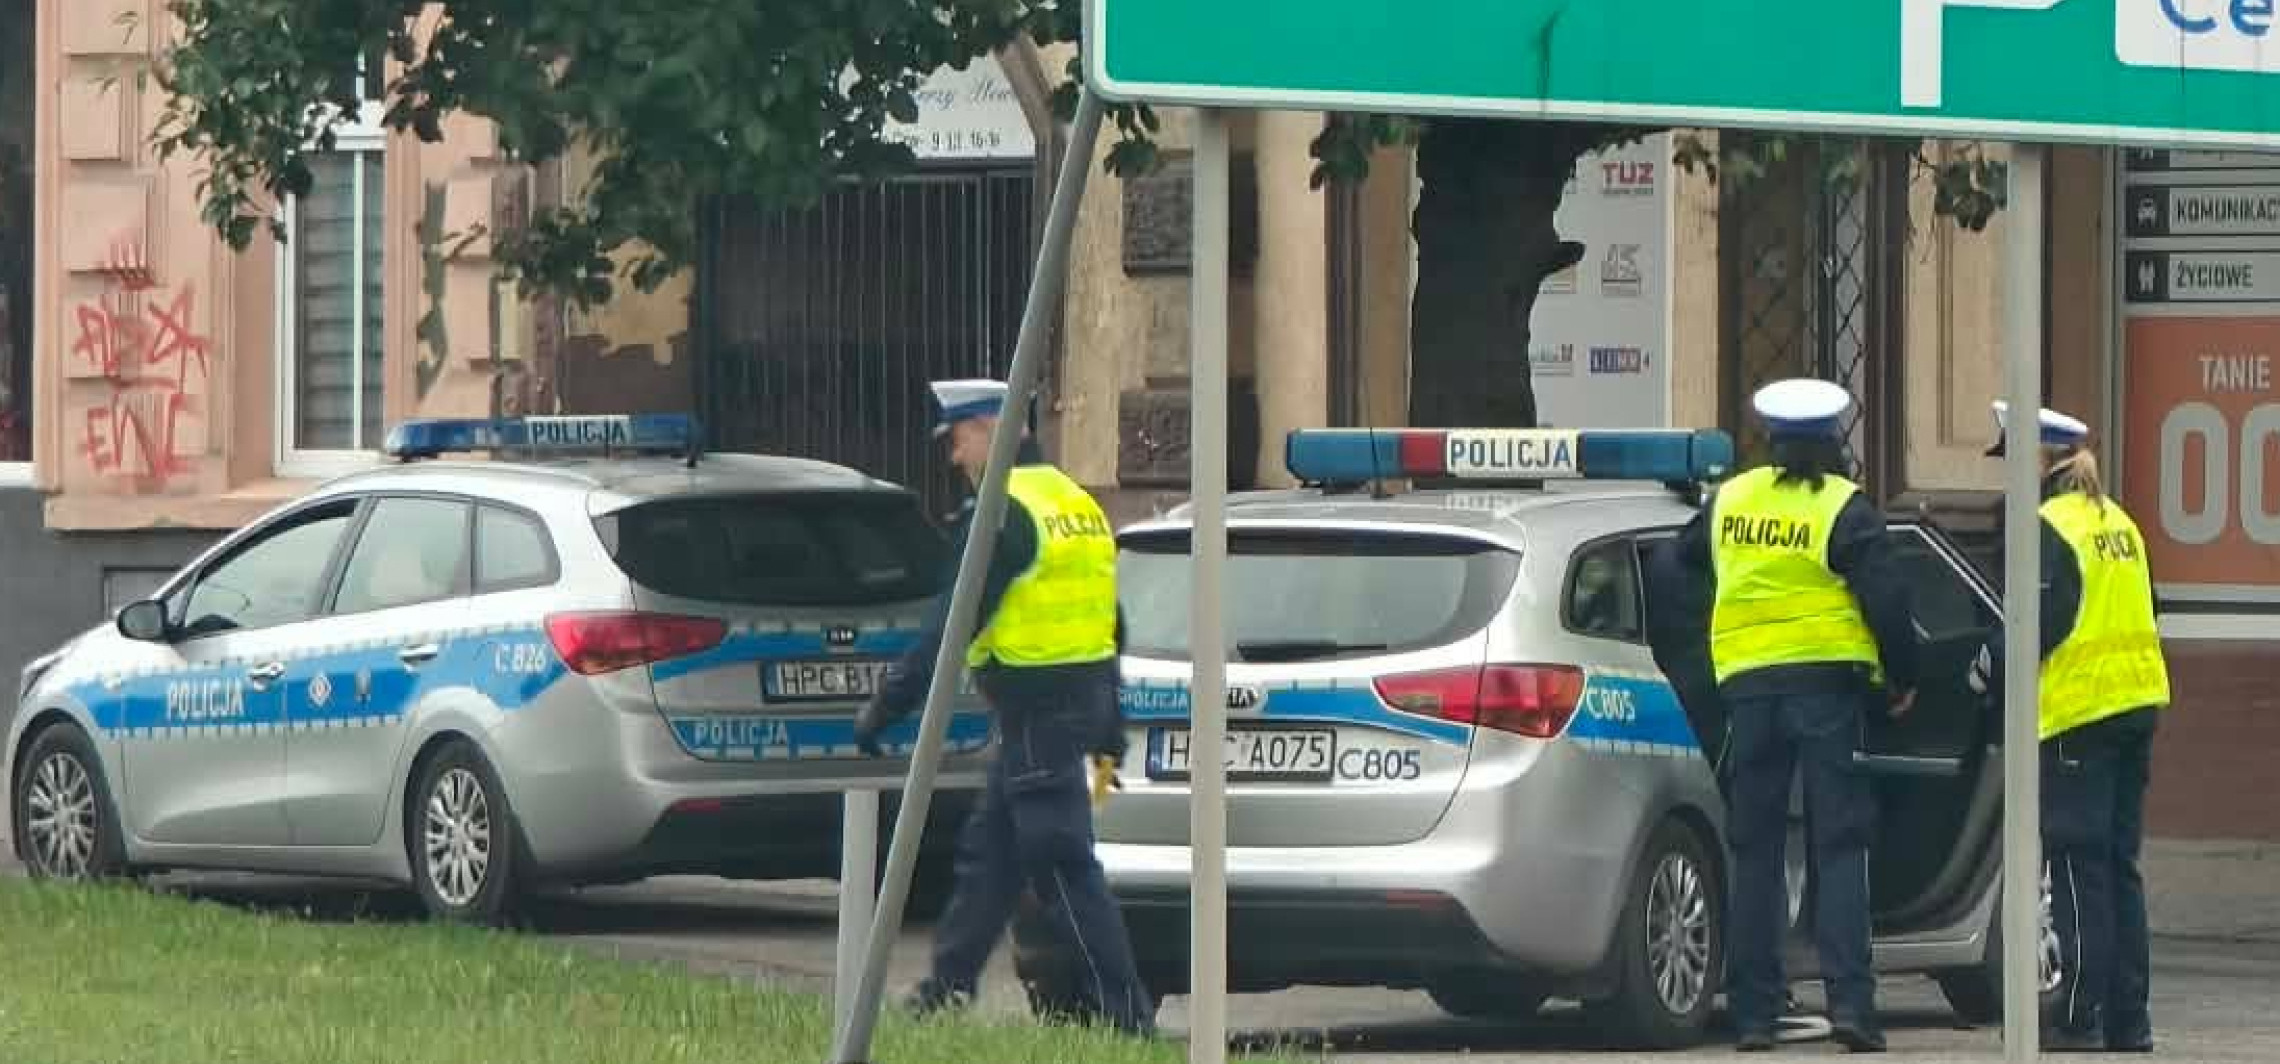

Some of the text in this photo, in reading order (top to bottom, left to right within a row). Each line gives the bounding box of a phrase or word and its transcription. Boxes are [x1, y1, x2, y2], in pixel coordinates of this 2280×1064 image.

[1602, 162, 1654, 185] TUZ
[2199, 354, 2271, 391] TANIE
[532, 419, 627, 445] POLICJA
[1450, 439, 1571, 468] POLICJA
[1722, 515, 1810, 549] POLICJA
[167, 677, 245, 720] POLICJA
[694, 719, 787, 744] POLICJA
[1250, 735, 1326, 768] A075
[1337, 749, 1420, 780] C805
